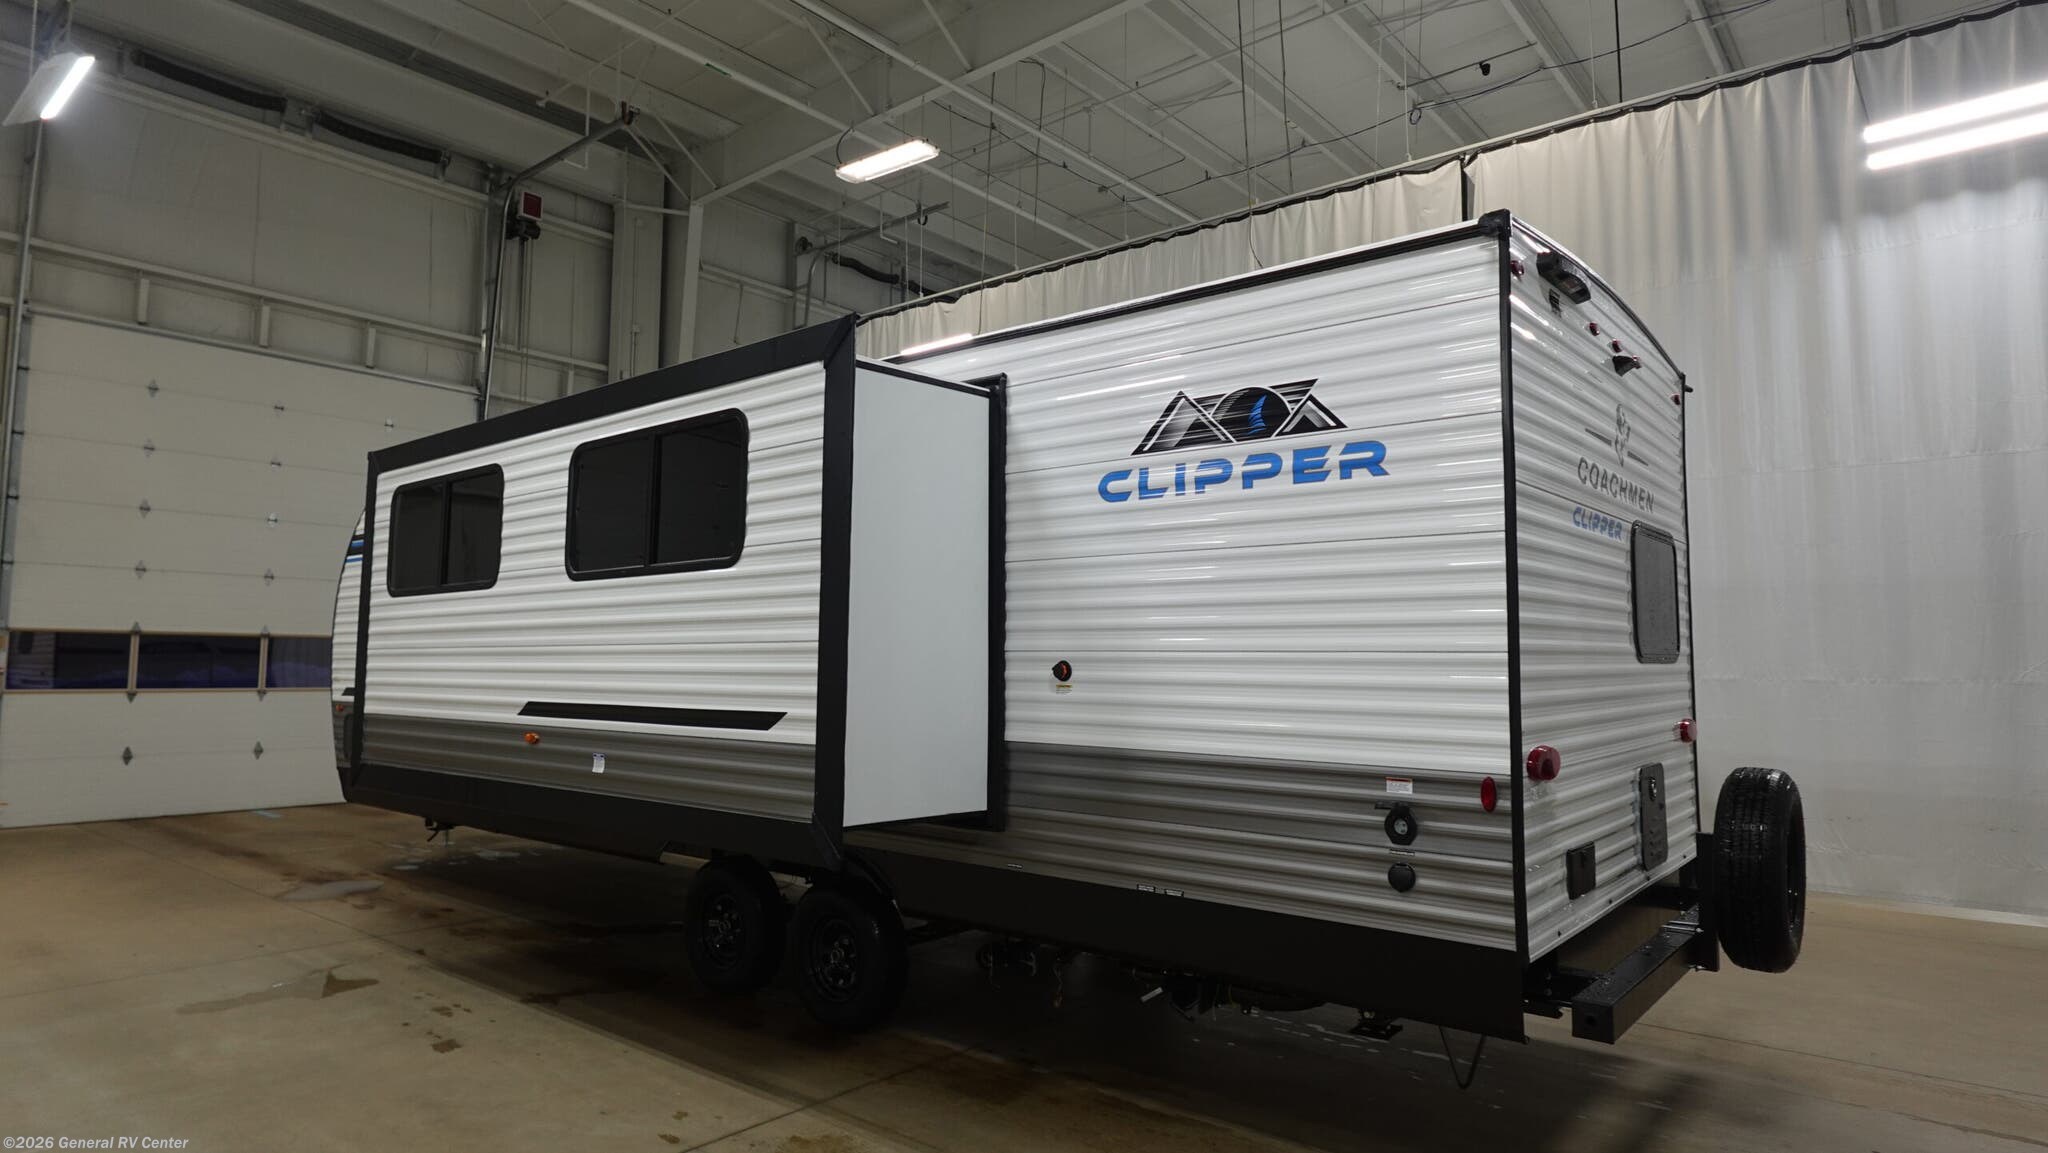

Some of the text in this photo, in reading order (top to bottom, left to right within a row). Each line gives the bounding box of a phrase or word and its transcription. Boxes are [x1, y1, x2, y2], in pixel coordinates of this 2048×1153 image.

[1098, 440, 1390, 503] CLIPPER
[1577, 457, 1655, 513] COACHMEN
[1572, 506, 1623, 541] CLIPPER
